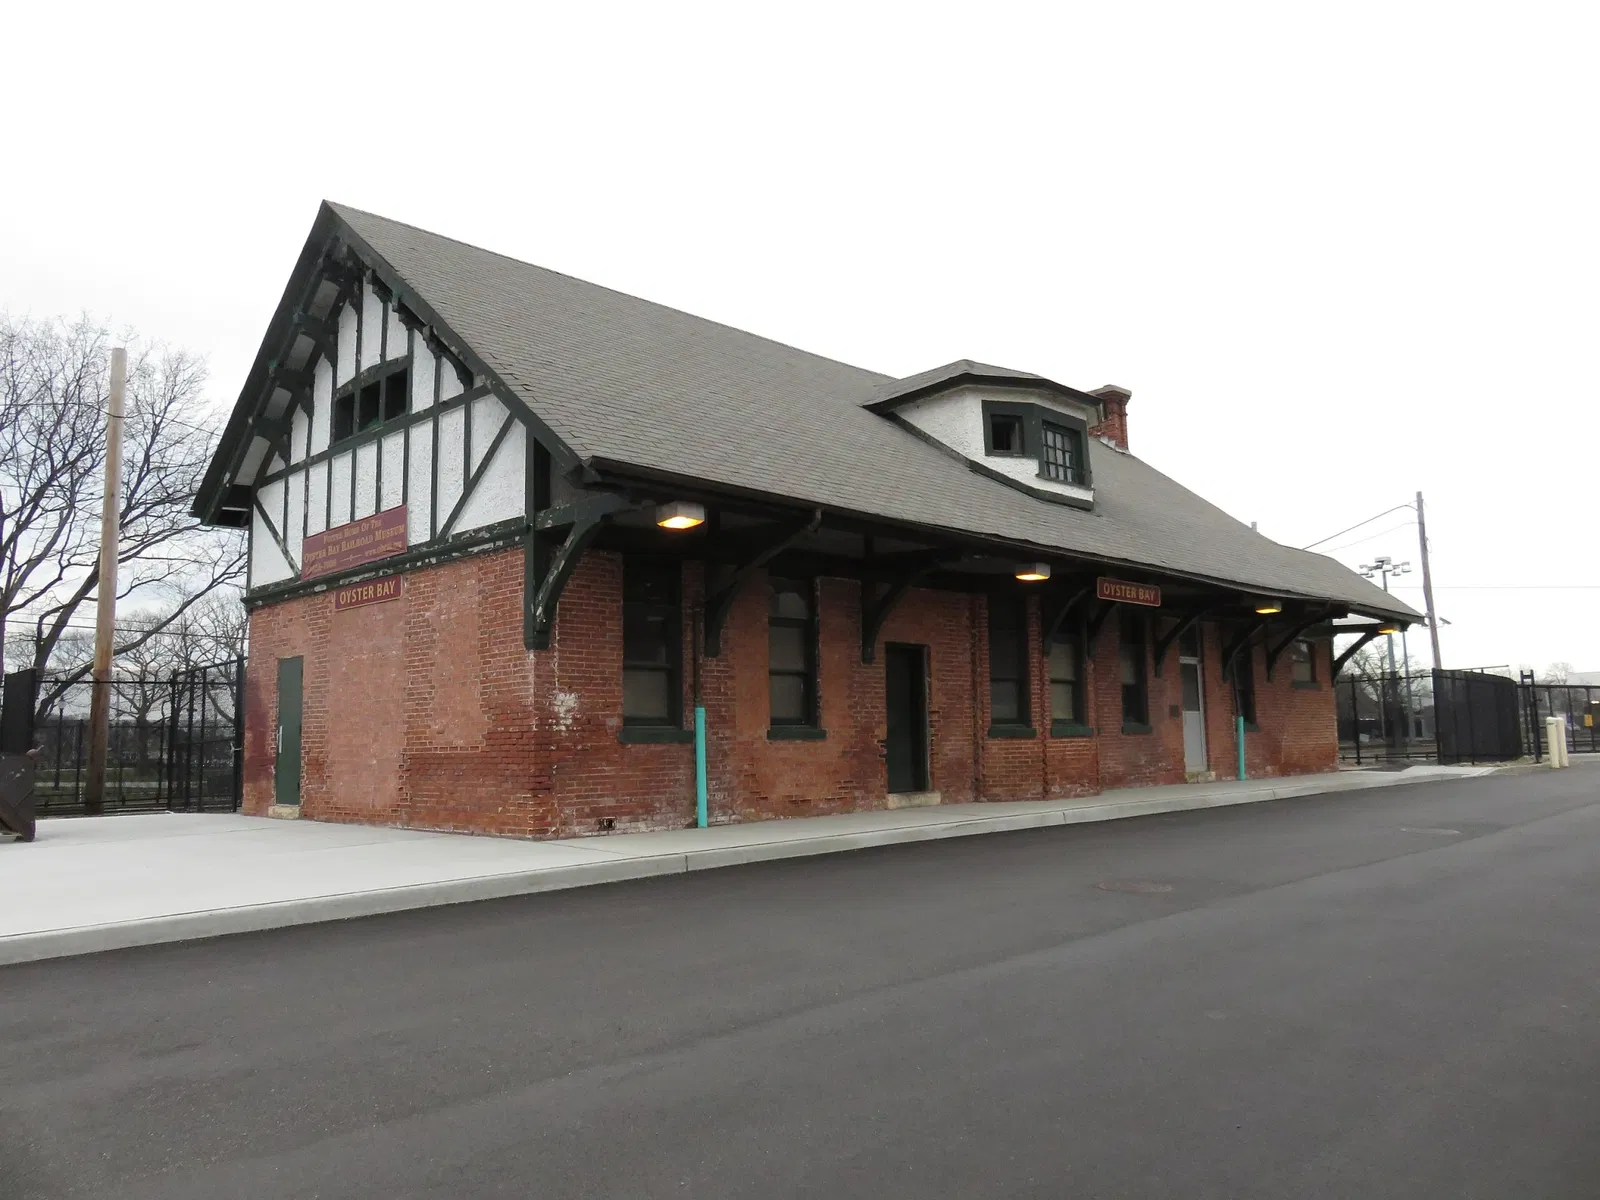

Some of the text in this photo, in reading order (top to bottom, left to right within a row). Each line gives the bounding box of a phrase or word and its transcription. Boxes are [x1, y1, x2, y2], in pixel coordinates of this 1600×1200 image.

[328, 545, 340, 556] BAY
[340, 581, 396, 604] OYSTER BAY
[1103, 583, 1156, 601] OYSTER BAY
